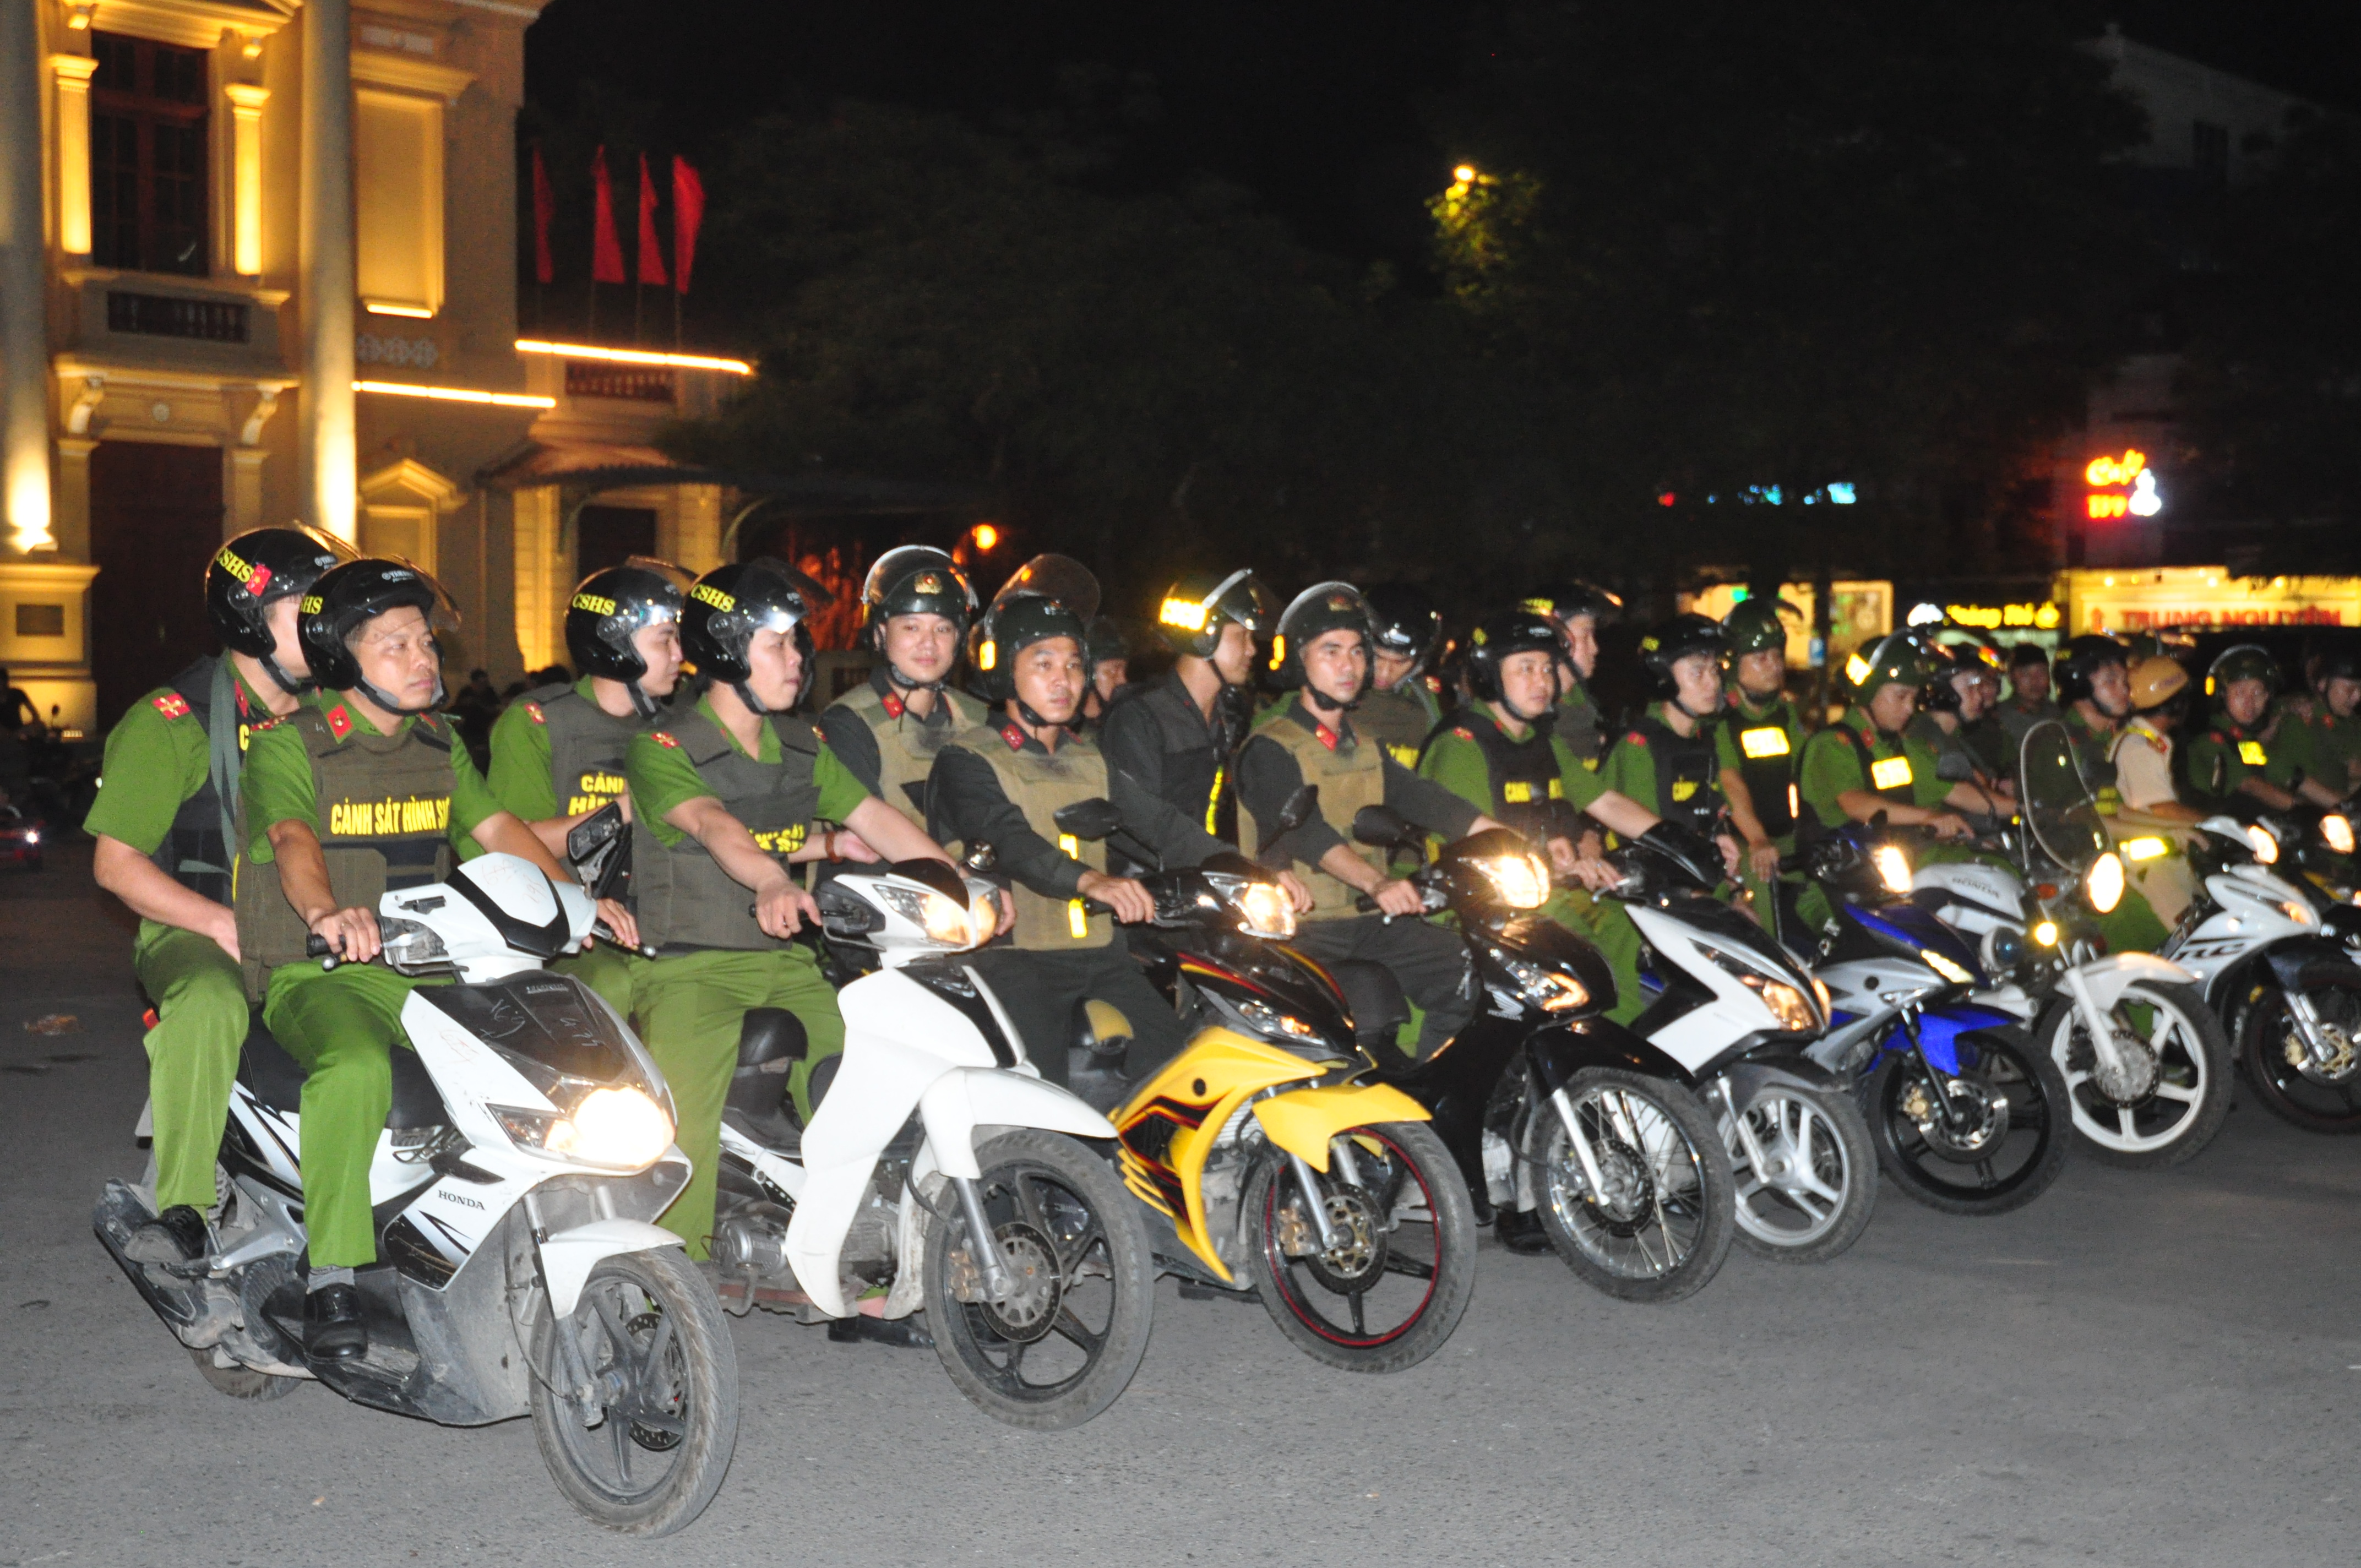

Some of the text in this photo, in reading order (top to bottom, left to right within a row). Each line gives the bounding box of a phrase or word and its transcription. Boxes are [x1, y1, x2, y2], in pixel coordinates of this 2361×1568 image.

[572, 593, 616, 616] CSHS
[690, 584, 736, 612] CSHS
[331, 797, 373, 835] CẢNH
[374, 797, 401, 834] SÁT
[402, 795, 437, 832] HÌNH
[438, 1189, 486, 1211] HONDA
